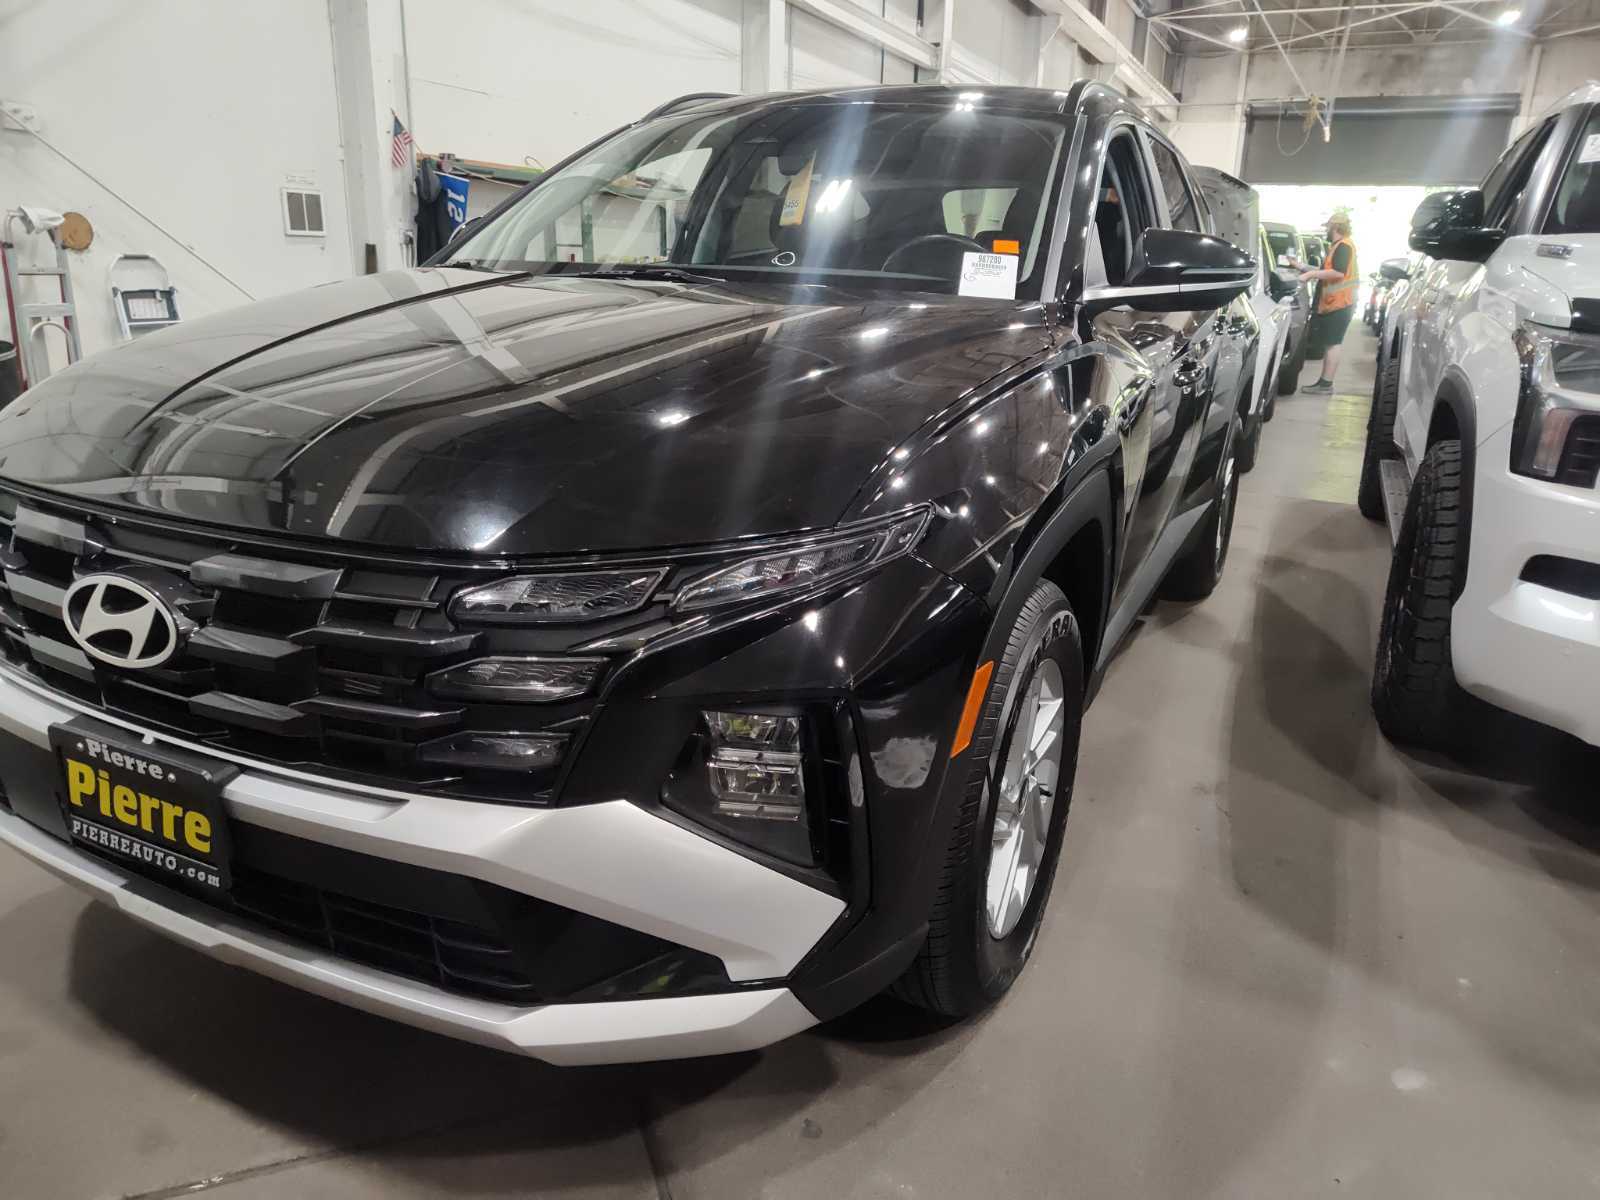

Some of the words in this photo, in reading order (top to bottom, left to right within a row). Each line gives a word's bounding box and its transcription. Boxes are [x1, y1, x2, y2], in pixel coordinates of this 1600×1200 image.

[85, 738, 164, 780] Pierre
[66, 758, 212, 853] Pierre
[72, 820, 221, 888] PIERREAUTO.com
